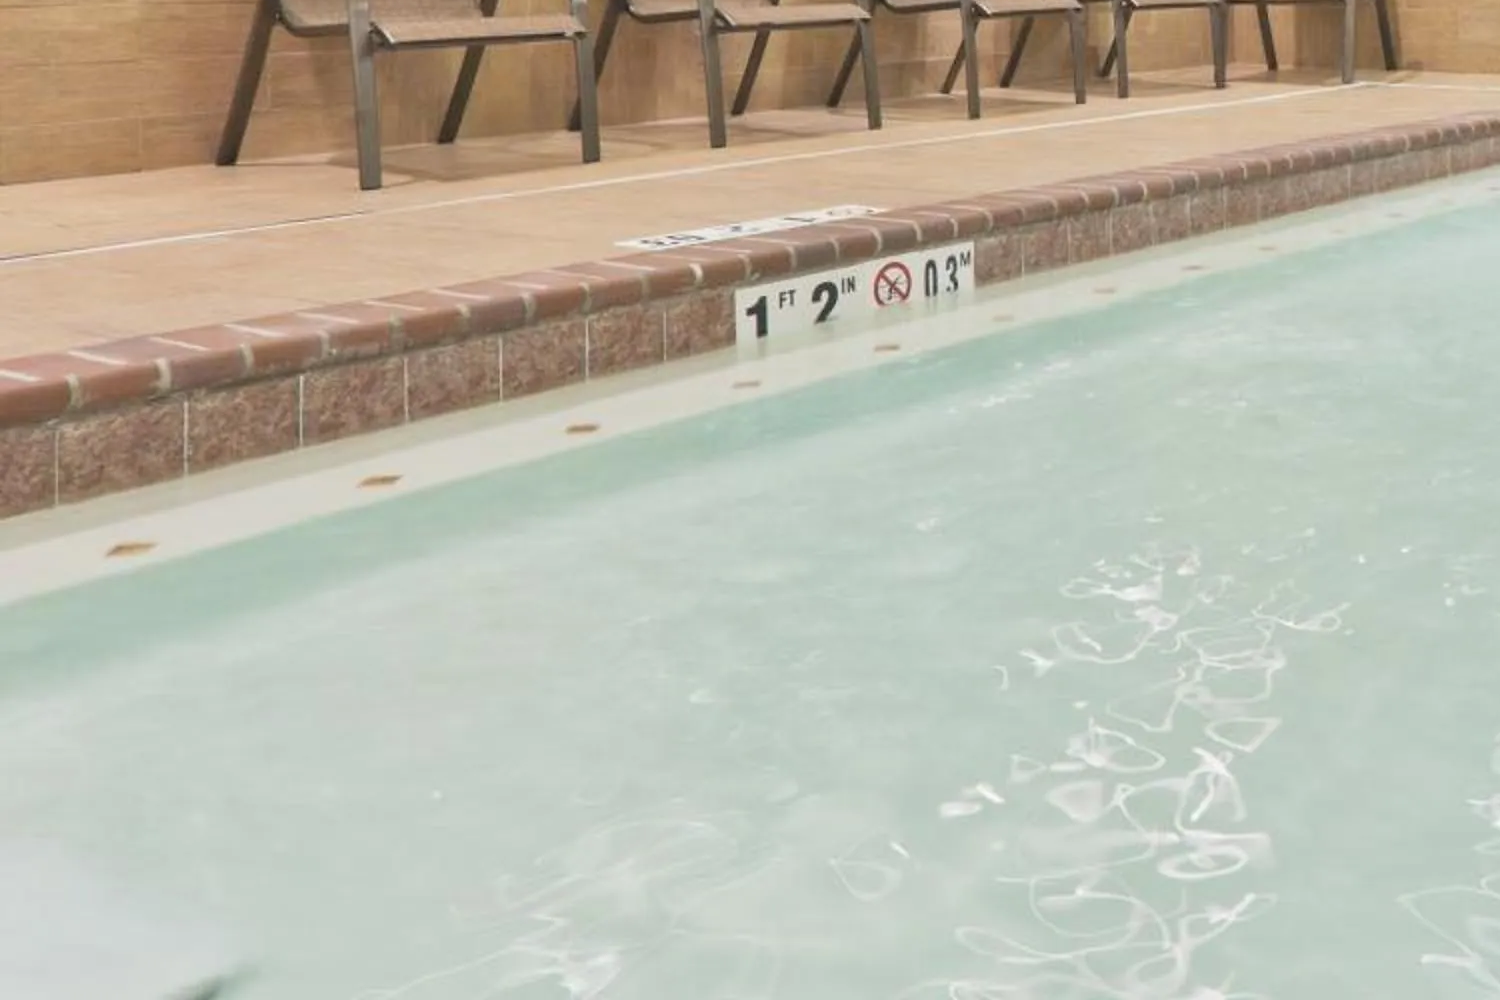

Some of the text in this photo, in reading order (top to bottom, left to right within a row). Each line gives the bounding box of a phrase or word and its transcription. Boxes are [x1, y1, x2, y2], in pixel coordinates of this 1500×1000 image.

[745, 295, 769, 338] 1
[778, 288, 797, 310] FT
[811, 281, 839, 324] 2
[841, 275, 856, 294] IN
